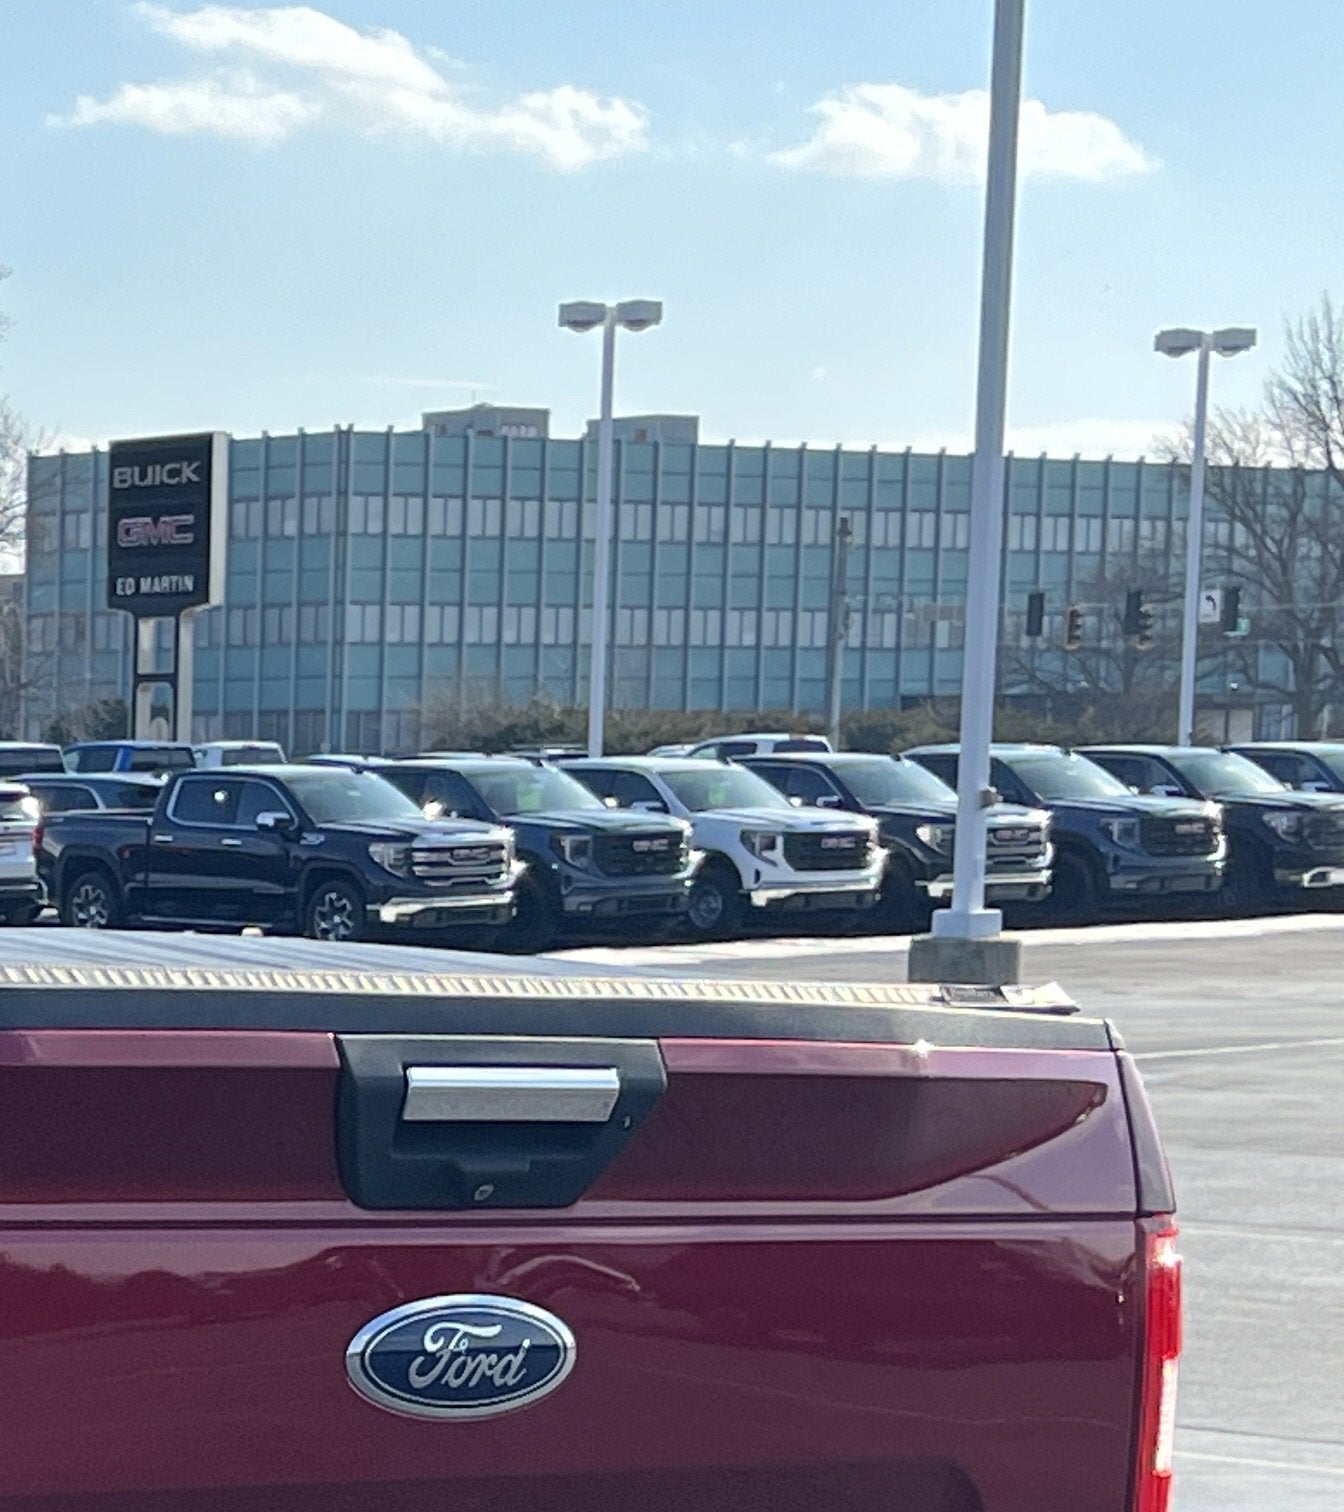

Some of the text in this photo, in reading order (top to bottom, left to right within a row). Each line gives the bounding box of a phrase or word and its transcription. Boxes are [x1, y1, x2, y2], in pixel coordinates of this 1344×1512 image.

[113, 461, 201, 488] BUICK
[117, 514, 195, 547] GMC
[116, 575, 194, 596] ED MARTIN
[408, 1321, 530, 1388] Ford
